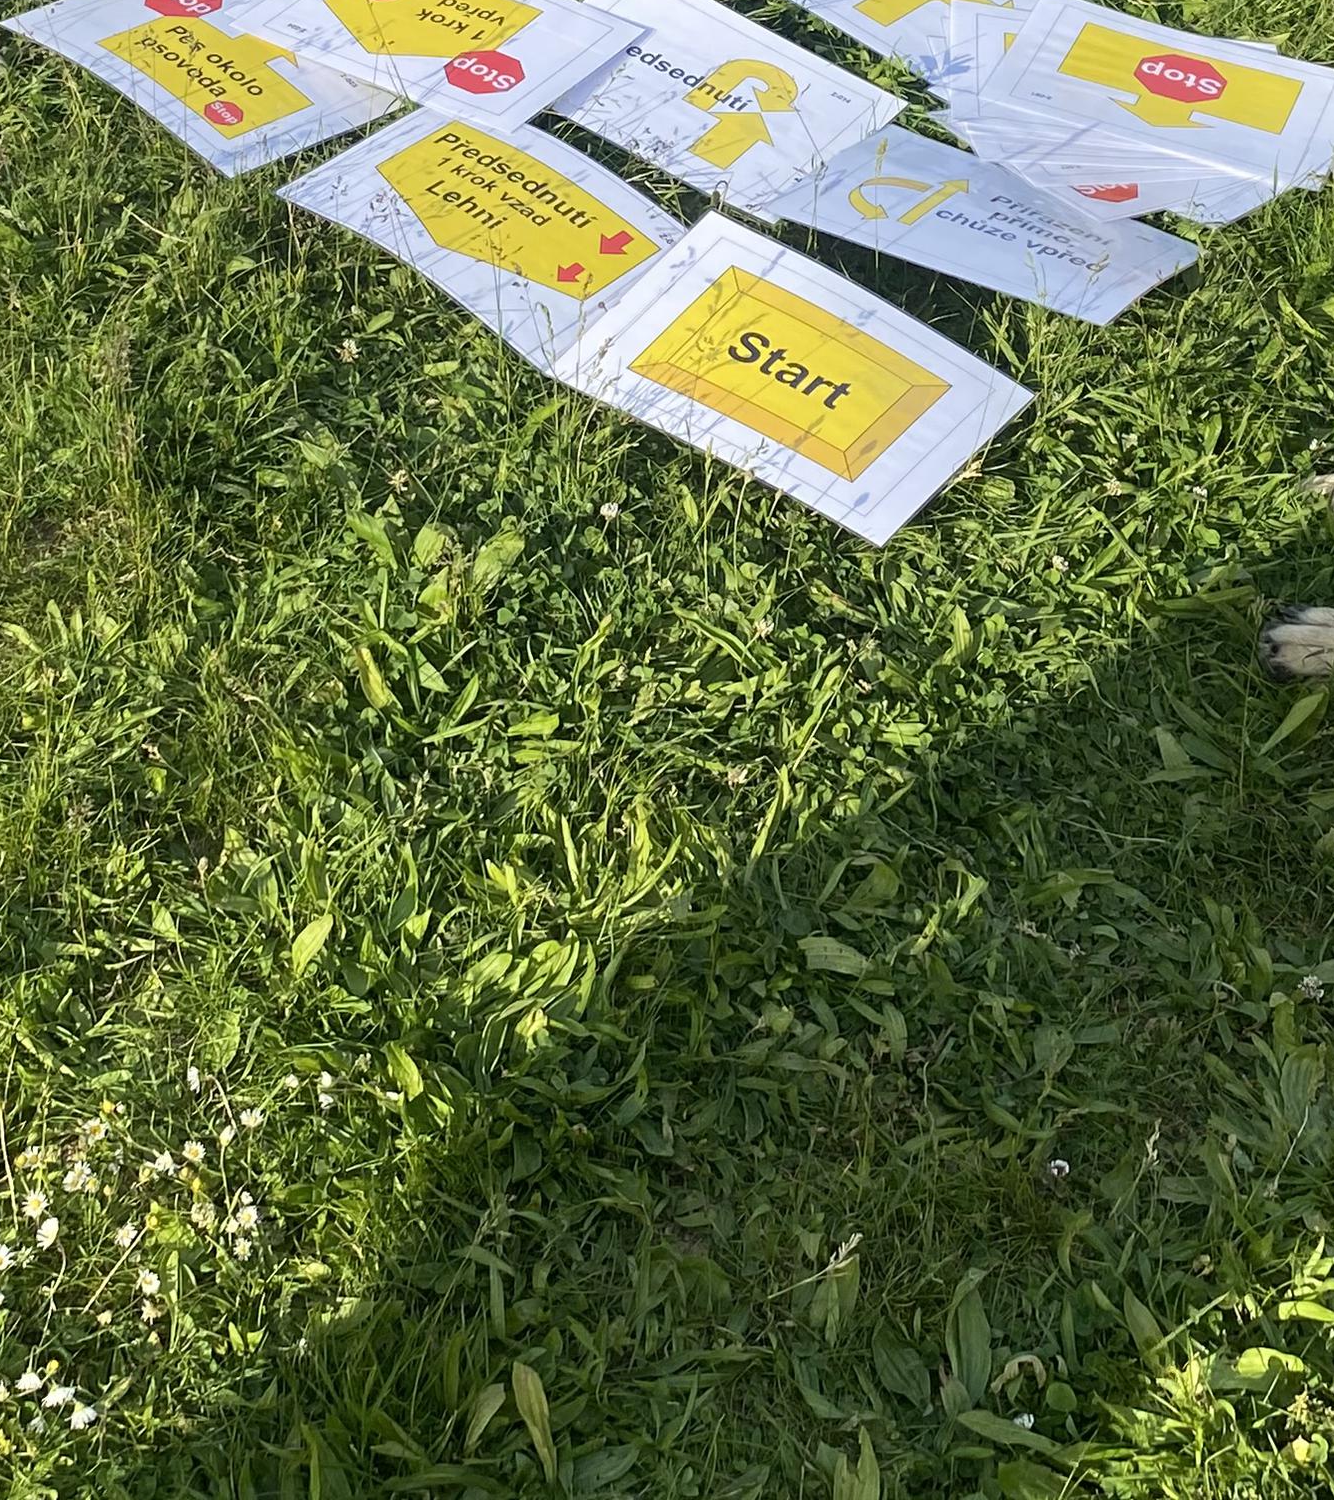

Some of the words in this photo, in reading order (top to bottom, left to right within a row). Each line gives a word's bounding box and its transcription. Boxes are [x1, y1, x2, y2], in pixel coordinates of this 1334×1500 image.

[415, 7, 470, 34] krok
[471, 30, 485, 41] 1
[135, 36, 227, 98] psovoda
[206, 53, 263, 96] okolo
[453, 55, 517, 90] Stop
[625, 44, 754, 112] edsednutí
[1140, 60, 1223, 96] Stop
[210, 101, 238, 125] Stop
[425, 179, 508, 230] Lehni
[433, 132, 599, 229] Předsednutí
[436, 156, 452, 168] 1
[450, 164, 498, 193] krok
[500, 191, 552, 227] vzad
[935, 209, 1018, 242] chůze
[1027, 240, 1110, 272] vpřed
[728, 331, 851, 410] Start
